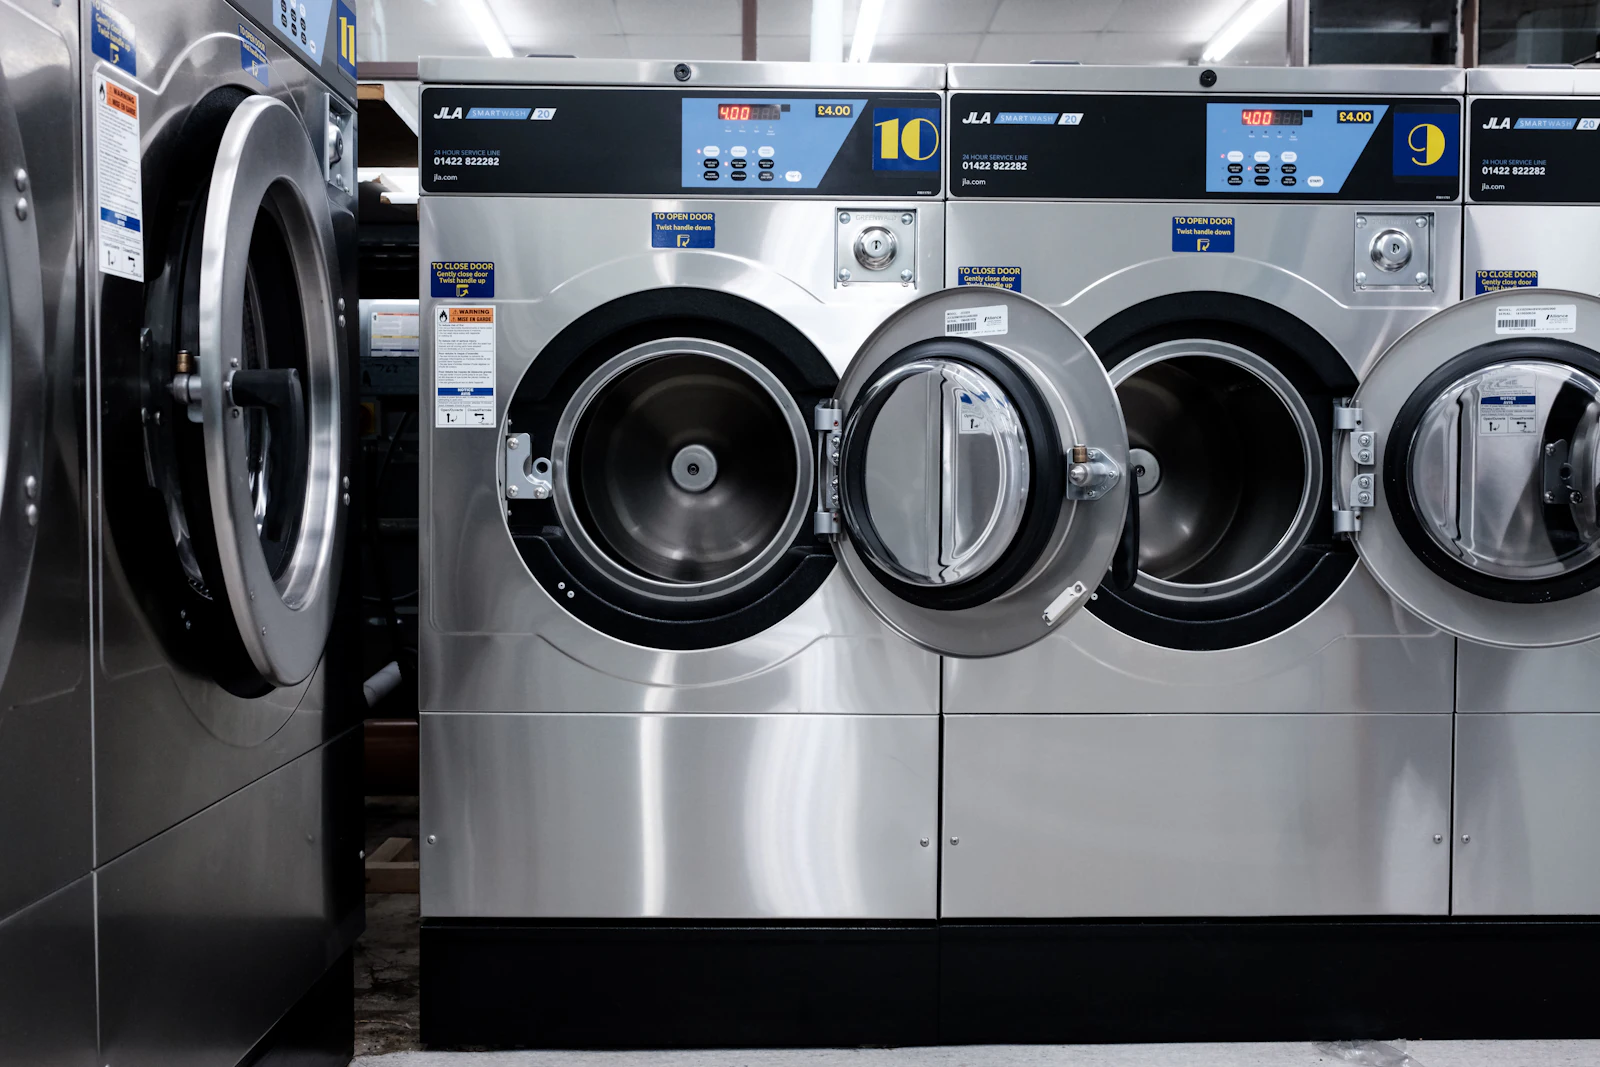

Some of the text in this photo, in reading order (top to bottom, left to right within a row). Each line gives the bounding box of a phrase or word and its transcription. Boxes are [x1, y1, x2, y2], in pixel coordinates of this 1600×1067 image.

[240, 25, 245, 35] TO
[339, 17, 355, 67] 11
[113, 88, 135, 104] WARNING
[434, 107, 462, 119] JLA
[537, 110, 550, 118] 20
[720, 106, 749, 120] 4.00
[818, 106, 850, 116] £4.00
[1339, 112, 1371, 122] £4.00
[962, 112, 991, 124] JLA
[1065, 115, 1077, 123] 20
[1242, 112, 1272, 125] 4.00
[1482, 117, 1511, 129] JLA
[1582, 120, 1595, 128] 20
[874, 118, 939, 160] 10
[1408, 123, 1445, 166] 9
[434, 157, 499, 166] 01422 822282
[962, 162, 1027, 170] 01422 822282
[1482, 167, 1545, 175] 01422 822282
[434, 173, 458, 182] jla.com
[962, 178, 986, 186] jla.com
